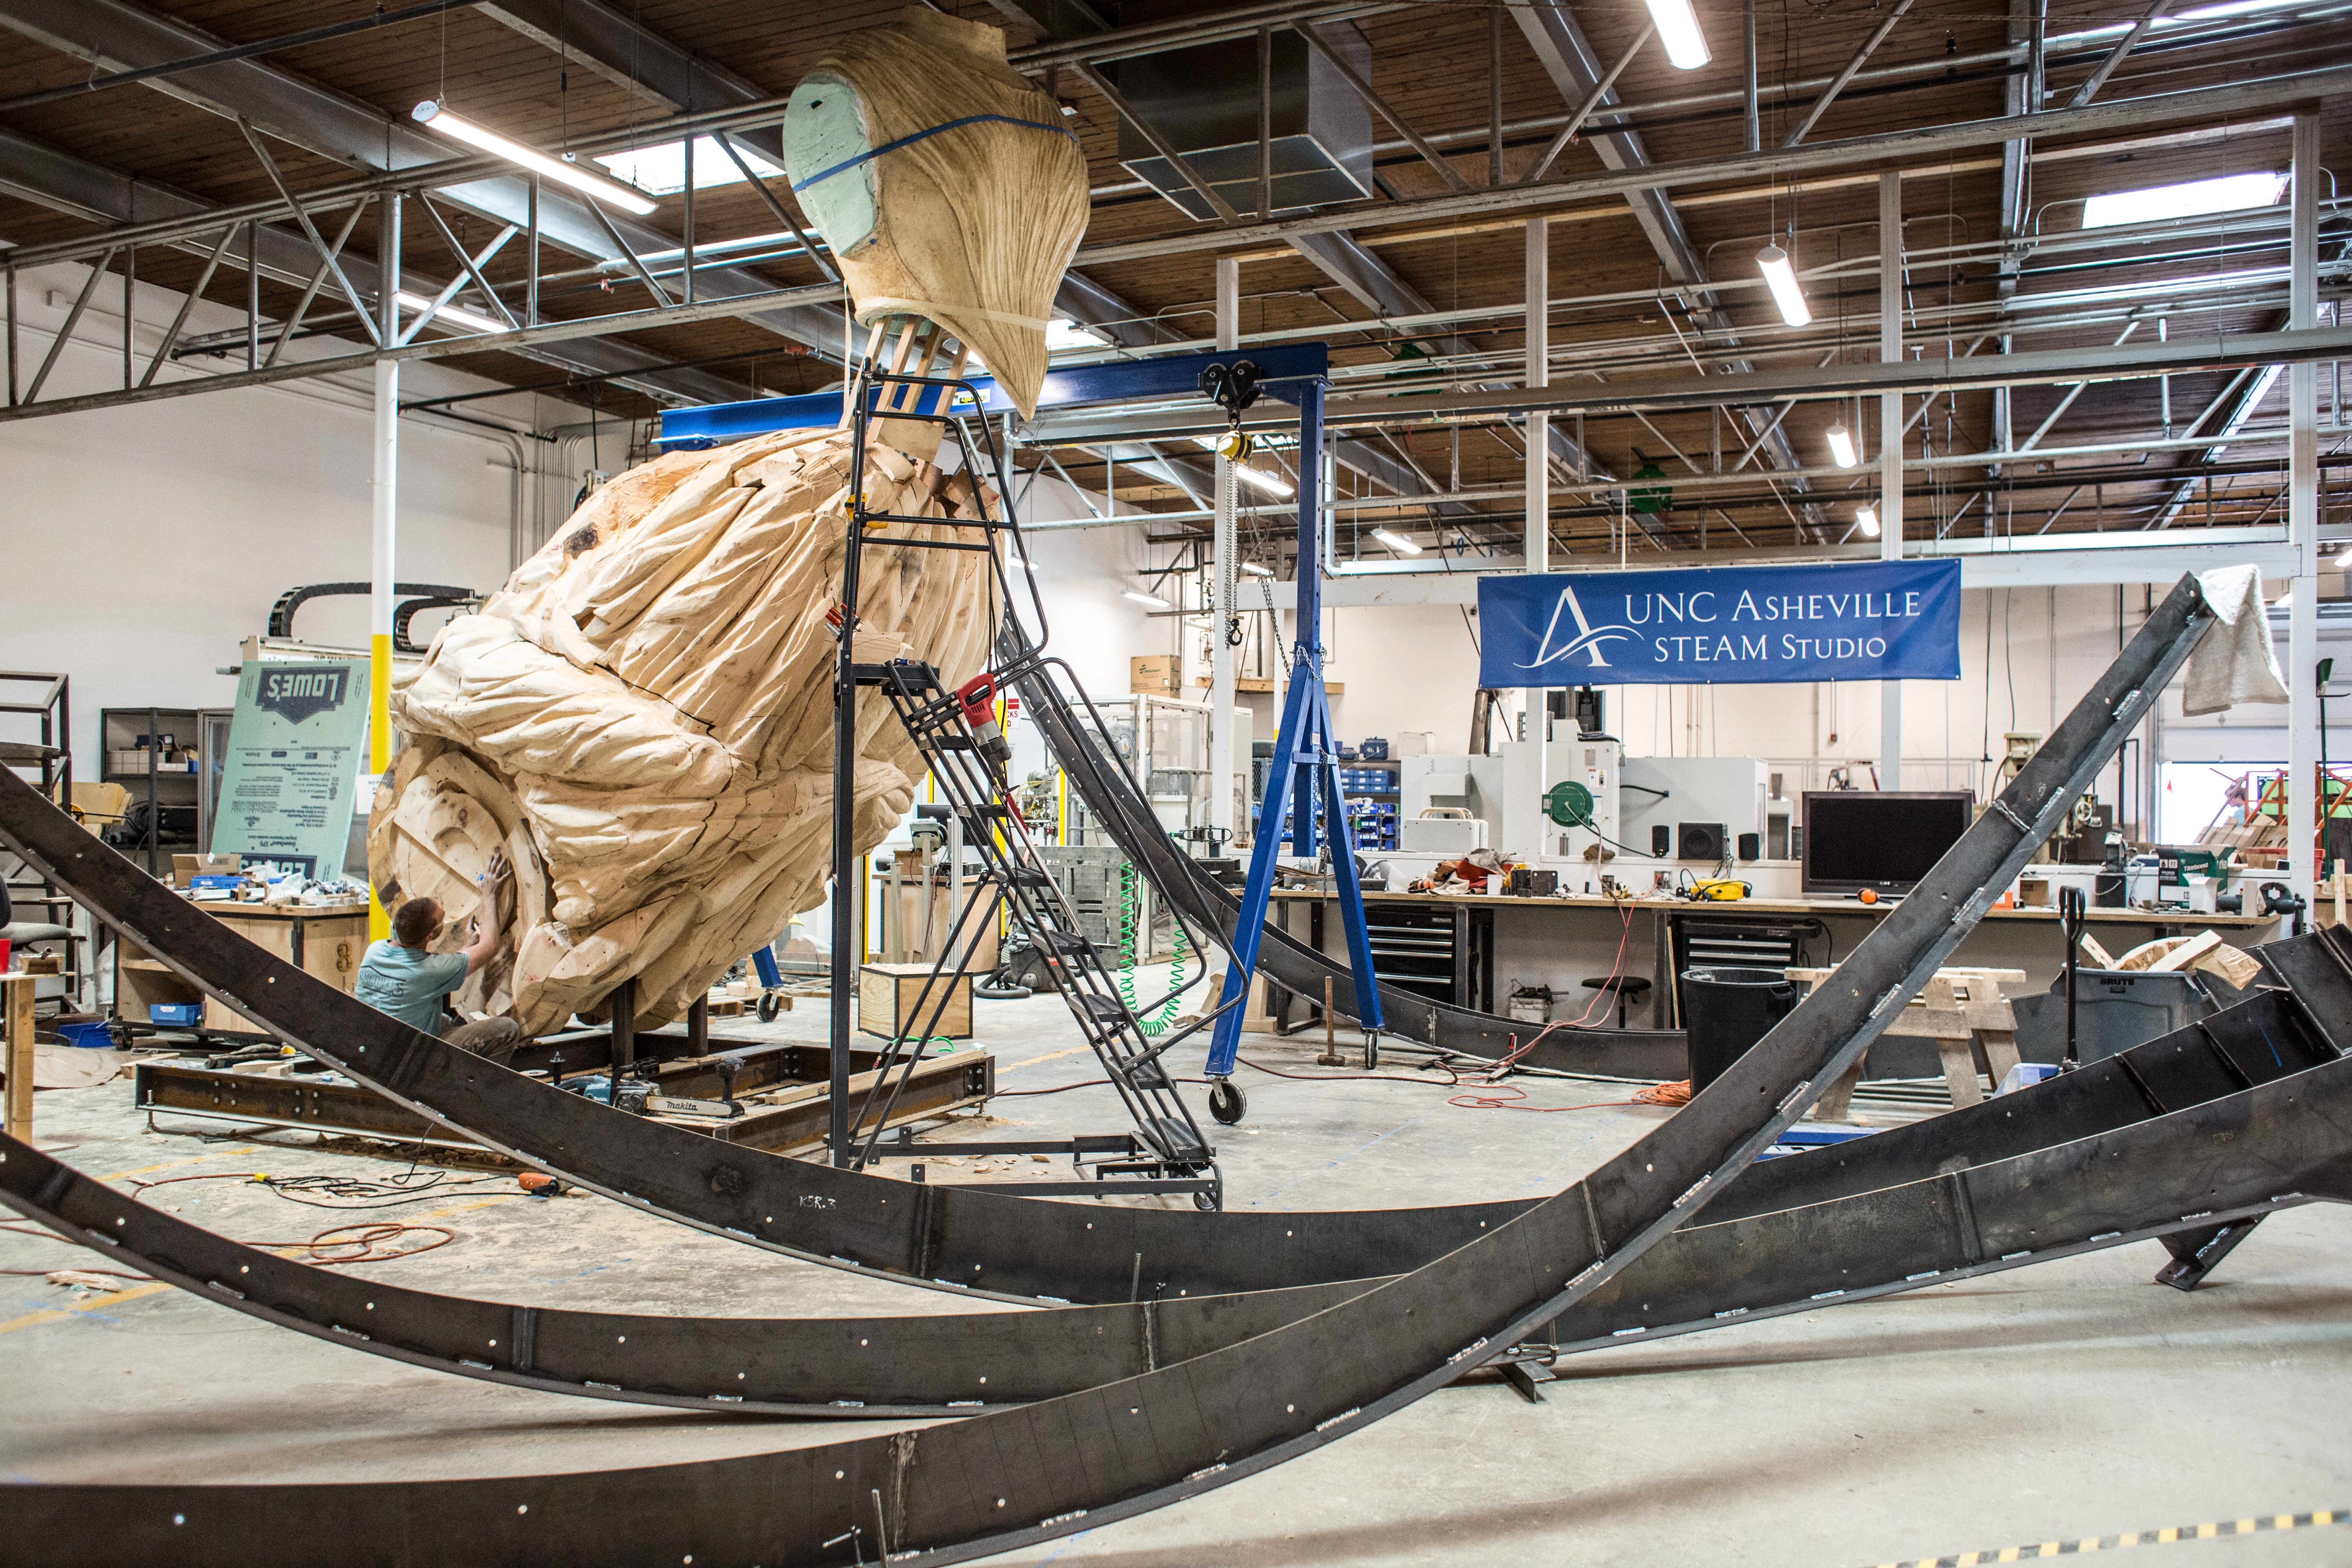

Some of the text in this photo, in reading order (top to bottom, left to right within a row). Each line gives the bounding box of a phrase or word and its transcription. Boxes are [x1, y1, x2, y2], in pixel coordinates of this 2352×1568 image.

[1625, 591, 1717, 625] UNC
[1654, 634, 1768, 663] STEAM
[267, 673, 339, 702] LOWE'S
[2100, 977, 2135, 985] BRUTE
